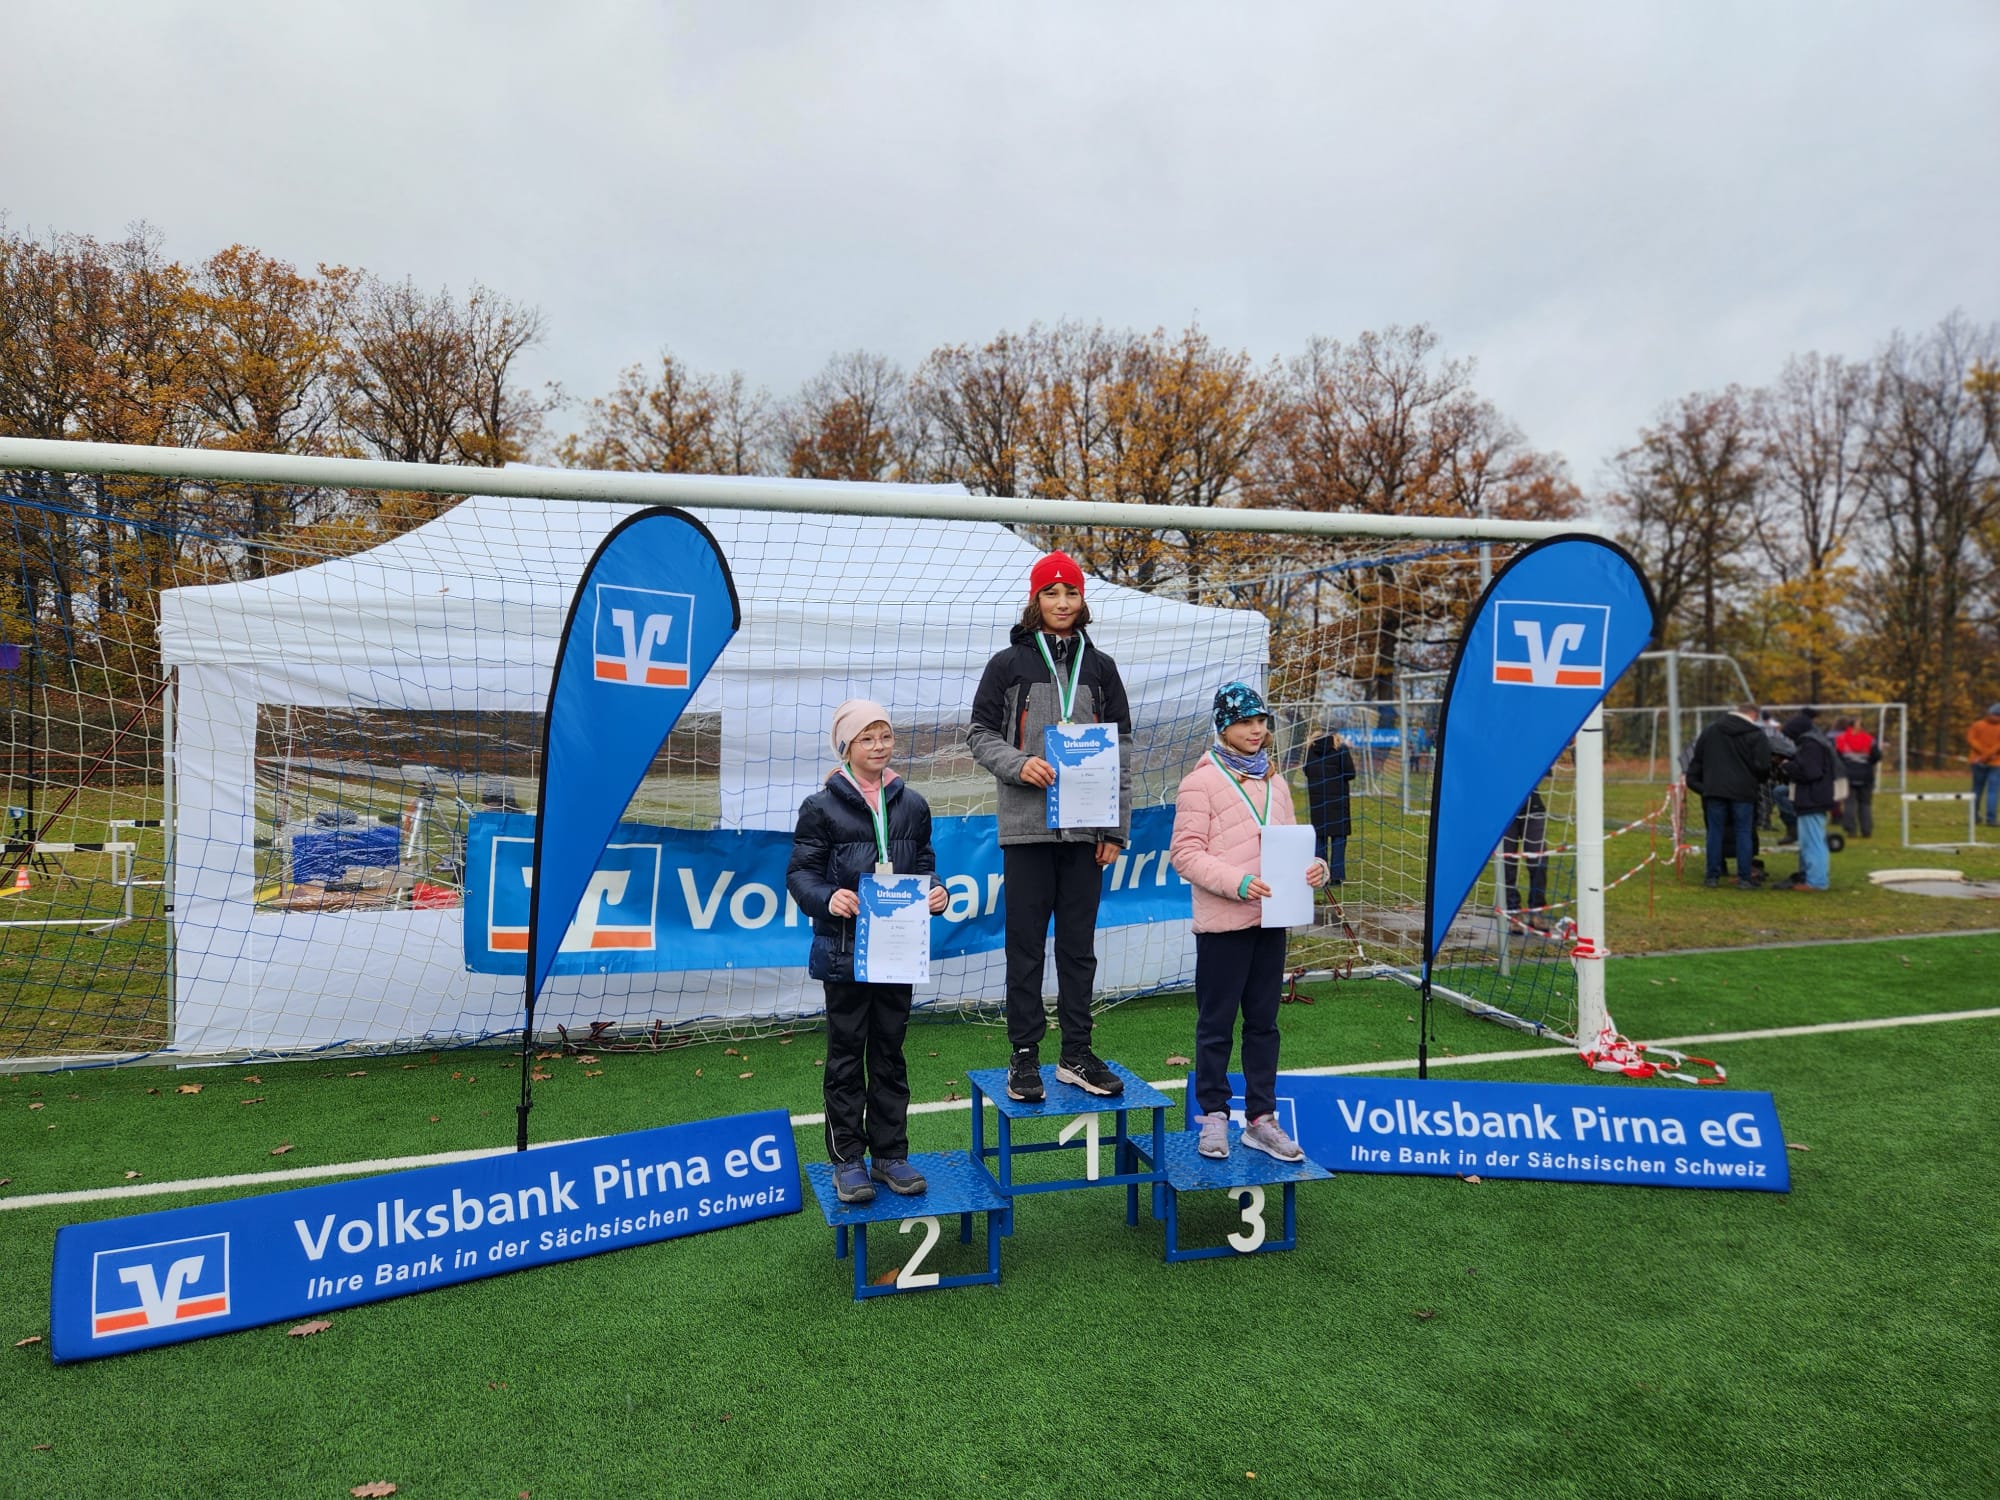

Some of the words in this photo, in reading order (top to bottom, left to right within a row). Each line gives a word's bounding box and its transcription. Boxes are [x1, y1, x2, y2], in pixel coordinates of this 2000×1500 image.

[1063, 740, 1101, 749] Urkunde
[876, 889, 912, 899] Urkunde
[1058, 1113, 1100, 1181] 1
[1336, 1098, 1562, 1140] Volksbank
[1572, 1105, 1687, 1146] Pirna
[1700, 1112, 1763, 1148] eG
[1351, 1145, 1391, 1163] Ihre
[1399, 1147, 1451, 1165] Bank
[1458, 1149, 1477, 1166] in
[1485, 1150, 1520, 1168] der
[1527, 1151, 1666, 1174] Sächsischen
[1674, 1157, 1767, 1178] Schweiz
[294, 1170, 580, 1261] Volksbank
[593, 1155, 711, 1206] Pirna
[724, 1134, 783, 1179] eG
[1226, 1185, 1267, 1254] 3
[307, 1274, 364, 1300] Ihre
[375, 1253, 445, 1286] Bank
[454, 1249, 478, 1269] in
[488, 1239, 530, 1262] der
[539, 1205, 689, 1251] Sächsischen
[698, 1186, 786, 1218] Schweiz
[896, 1216, 941, 1290] 2
